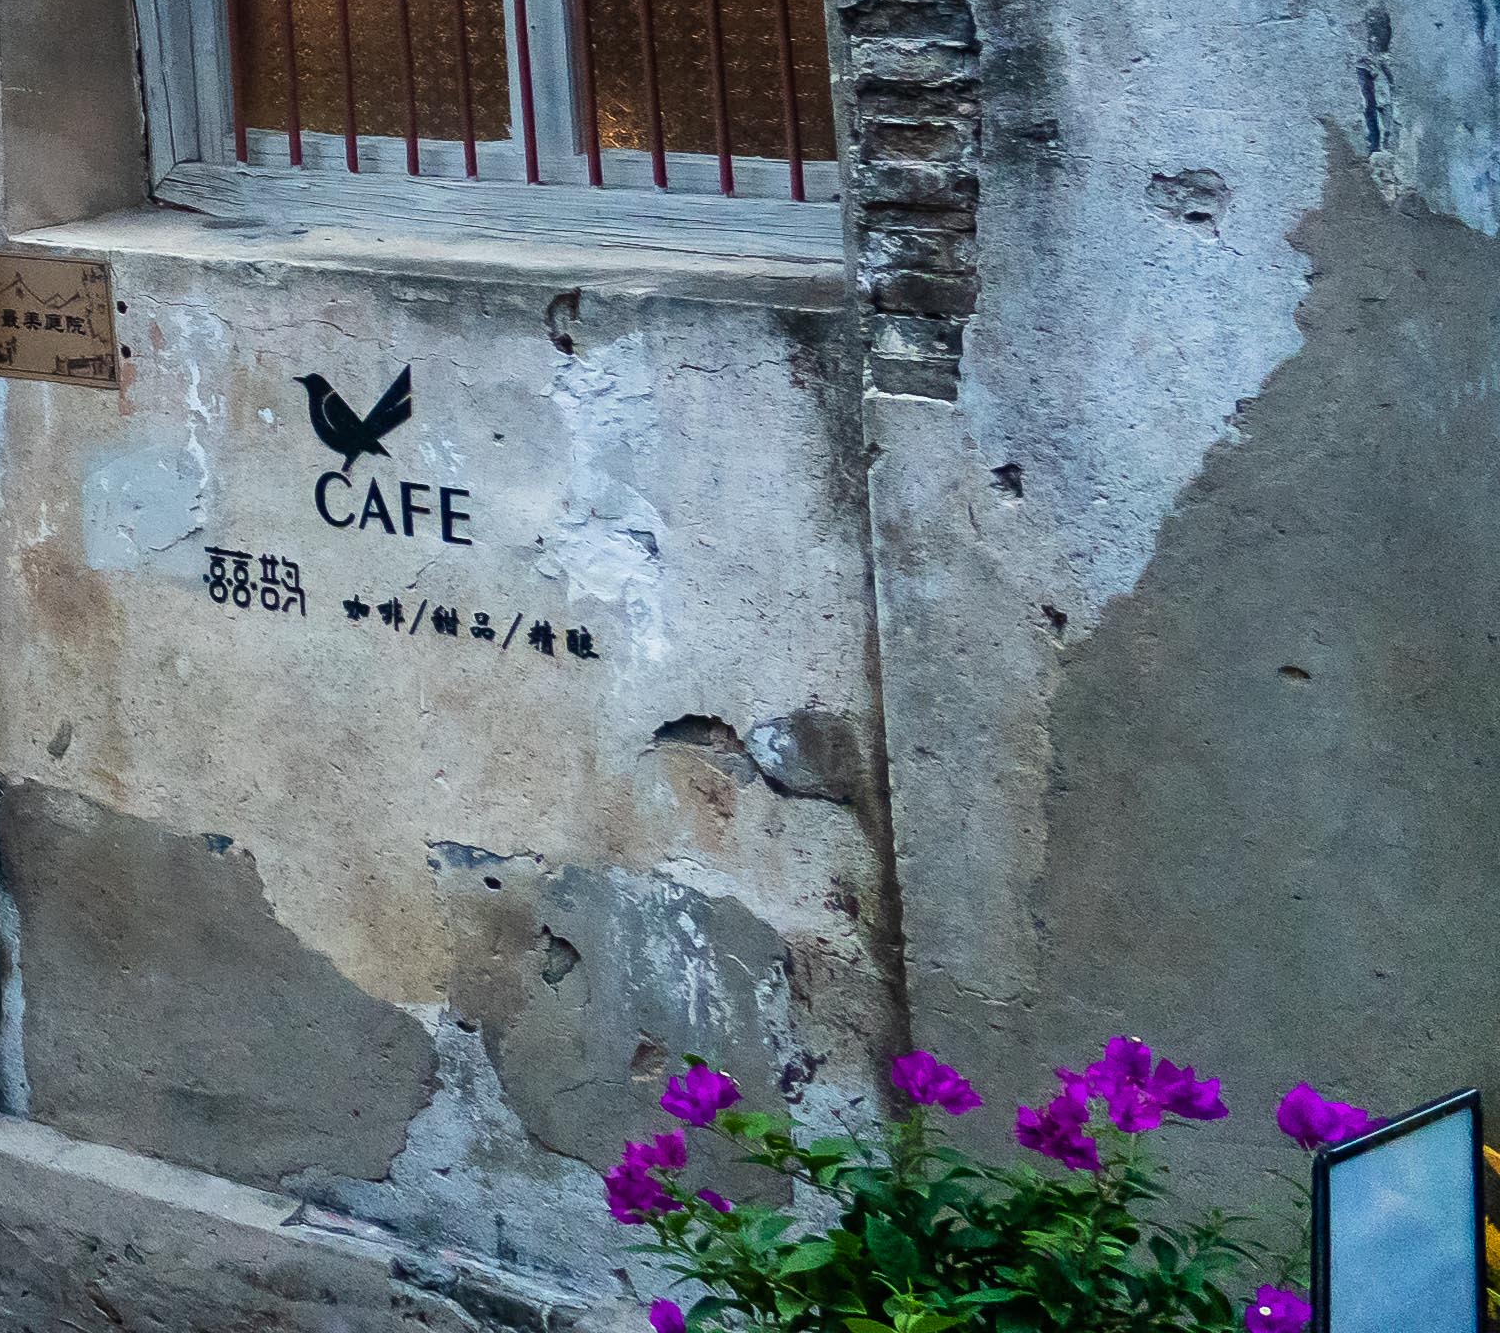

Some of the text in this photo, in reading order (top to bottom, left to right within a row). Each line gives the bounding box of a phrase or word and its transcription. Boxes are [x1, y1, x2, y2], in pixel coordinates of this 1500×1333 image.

[2, 308, 87, 336] 最美庭院
[313, 470, 474, 547] CAFE
